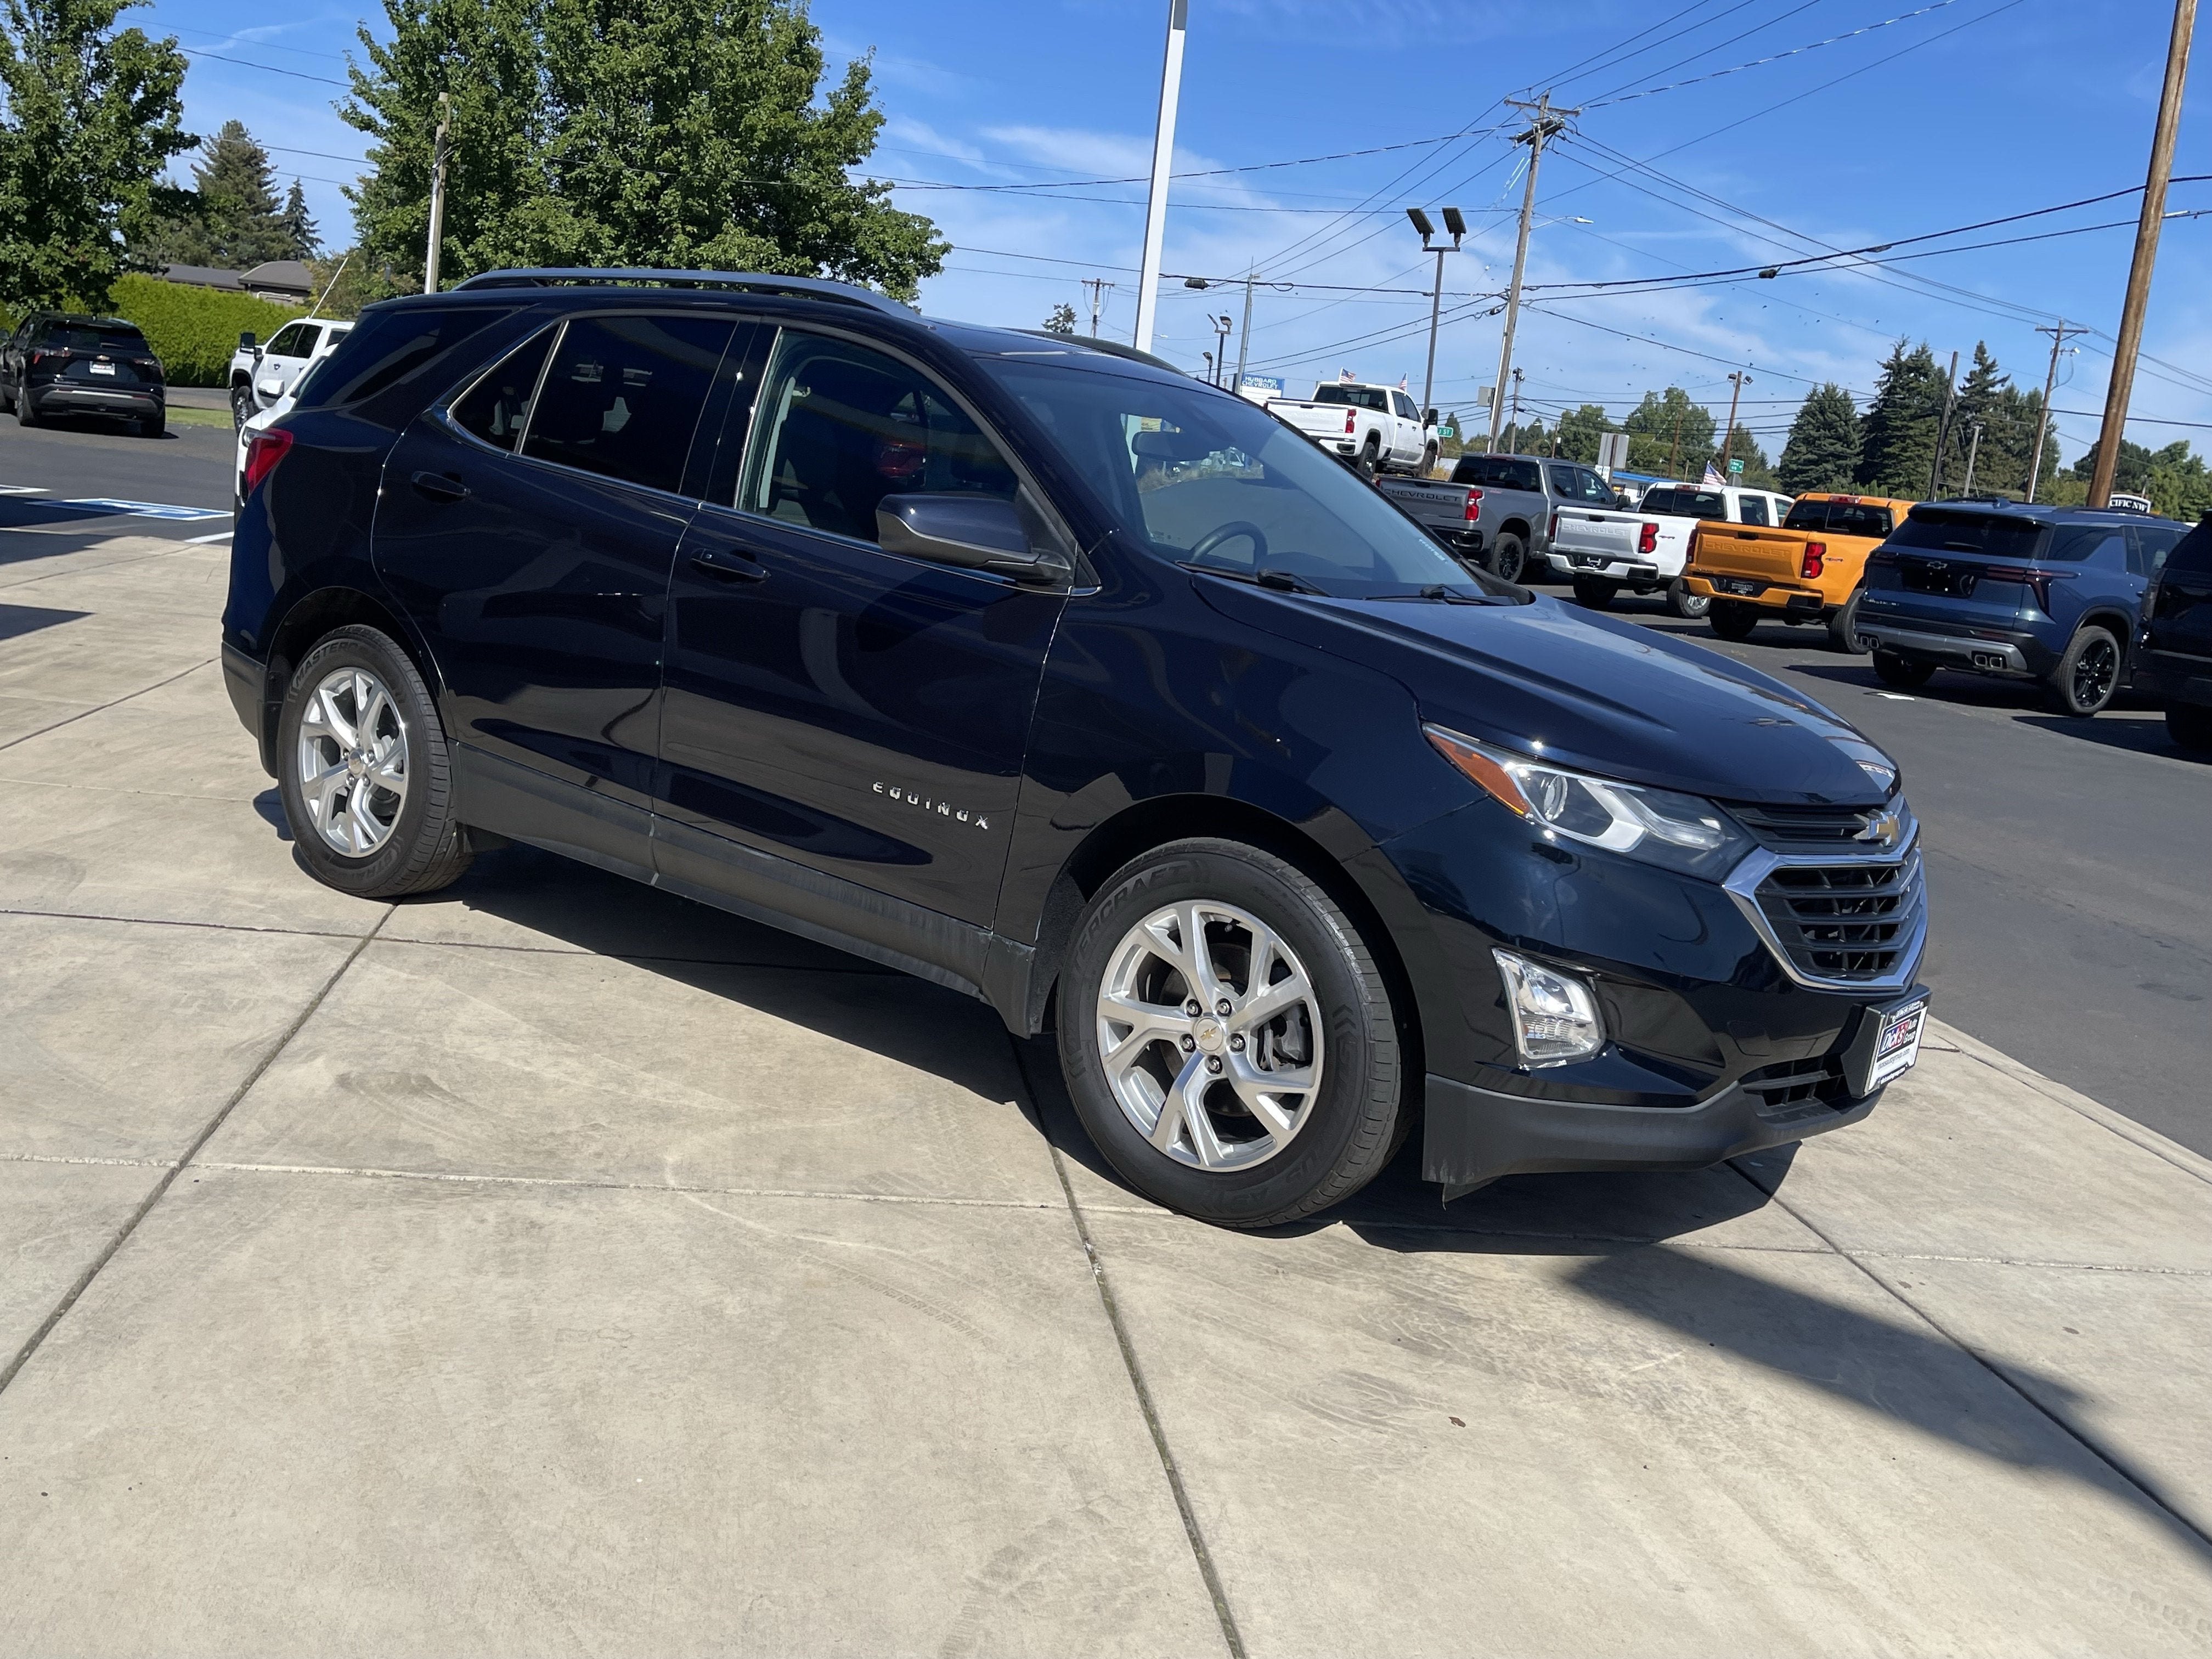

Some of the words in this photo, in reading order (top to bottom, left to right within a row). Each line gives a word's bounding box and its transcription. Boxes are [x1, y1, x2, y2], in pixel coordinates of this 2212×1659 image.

[1242, 380, 1278, 389] CHEVROLET
[1245, 376, 1277, 384] HUBBARD
[1384, 488, 1461, 502] CHEVROLET
[2109, 499, 2132, 508] CIFIC
[1562, 524, 1629, 536] CHEVROLET
[1704, 541, 1791, 557] CHEVROLET
[872, 781, 988, 830] EQUINOX
